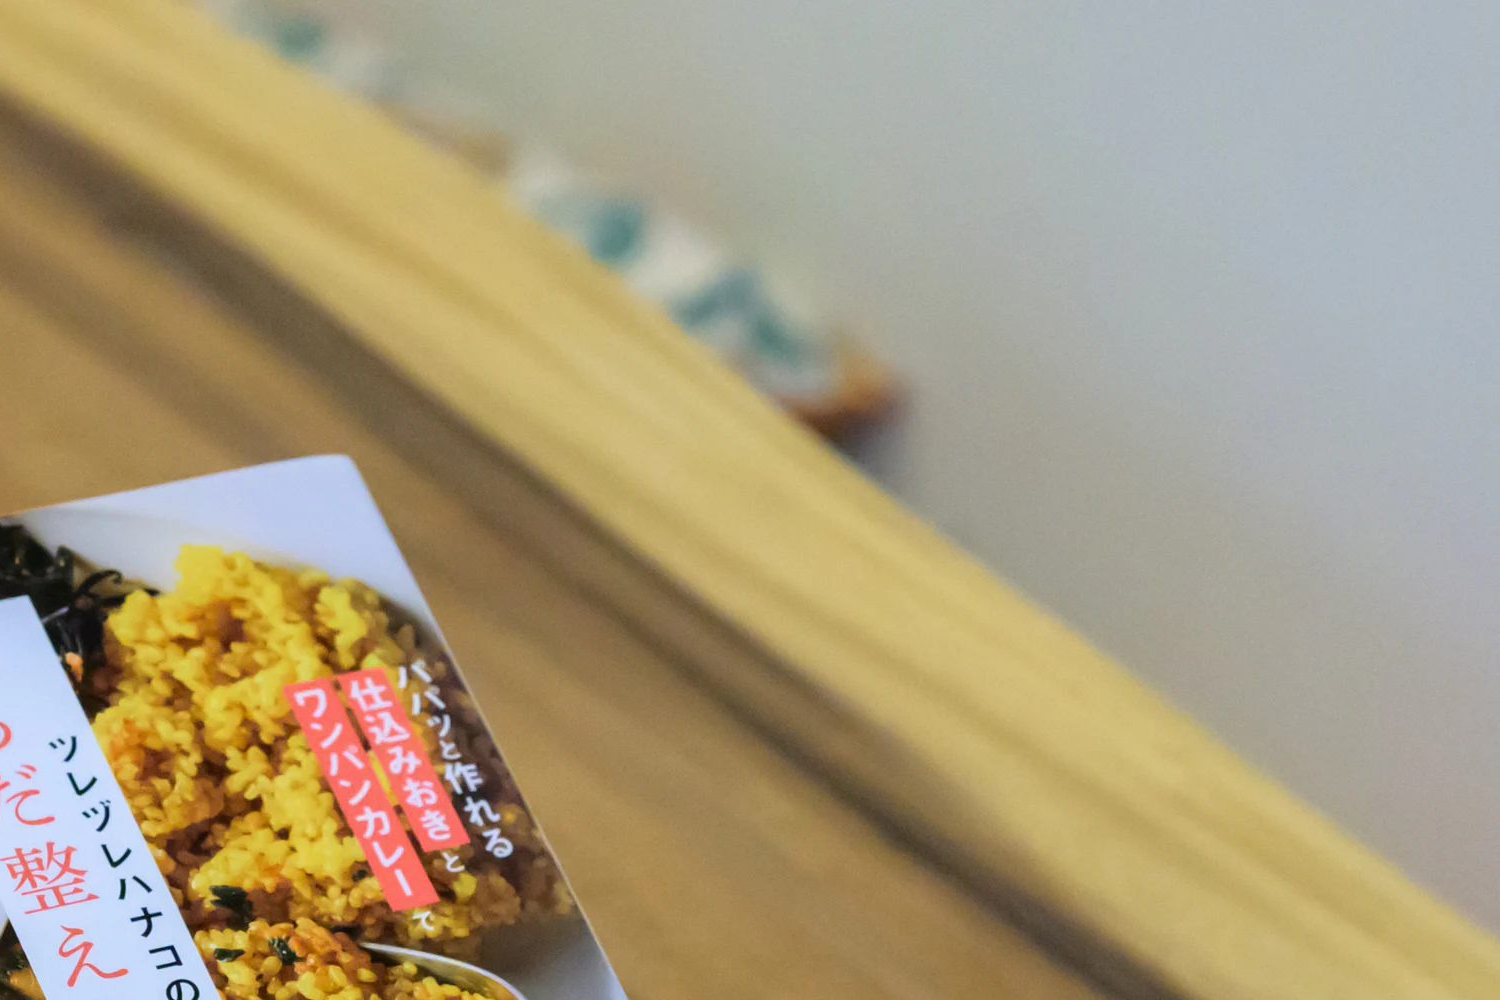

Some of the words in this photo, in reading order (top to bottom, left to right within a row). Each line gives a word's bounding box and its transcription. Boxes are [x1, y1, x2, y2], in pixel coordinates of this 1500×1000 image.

[399, 658, 514, 858] パパッと作れる
